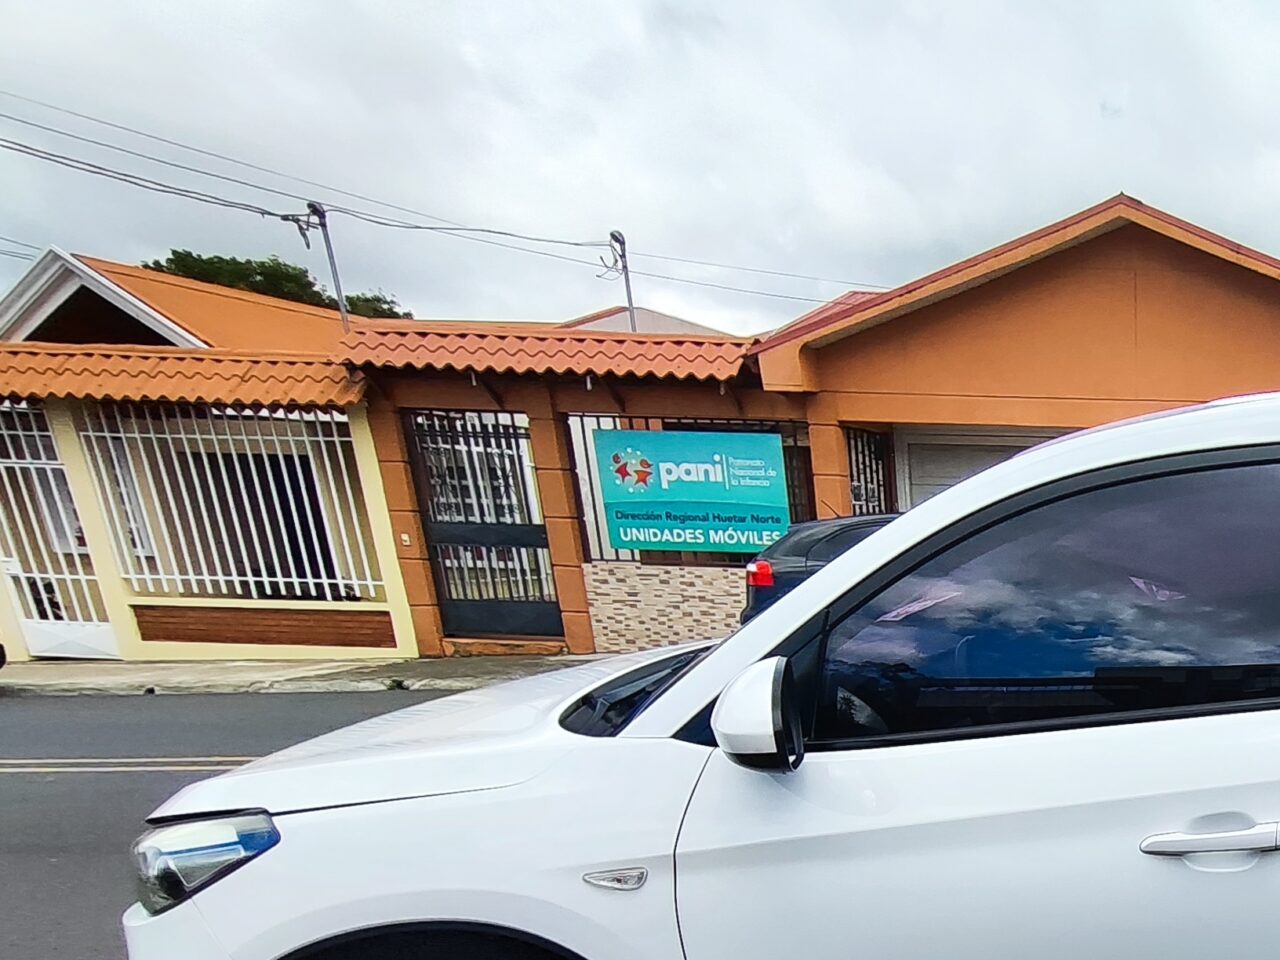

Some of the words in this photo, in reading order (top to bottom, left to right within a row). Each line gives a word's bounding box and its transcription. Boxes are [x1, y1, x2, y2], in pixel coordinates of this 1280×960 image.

[658, 453, 723, 490] pani
[615, 510, 663, 521] Dirección
[665, 511, 710, 525] Regional
[712, 512, 747, 524] Huetar
[750, 513, 782, 524] Norte
[619, 526, 705, 544] UNIDADES
[708, 526, 782, 546] MÓVILES
